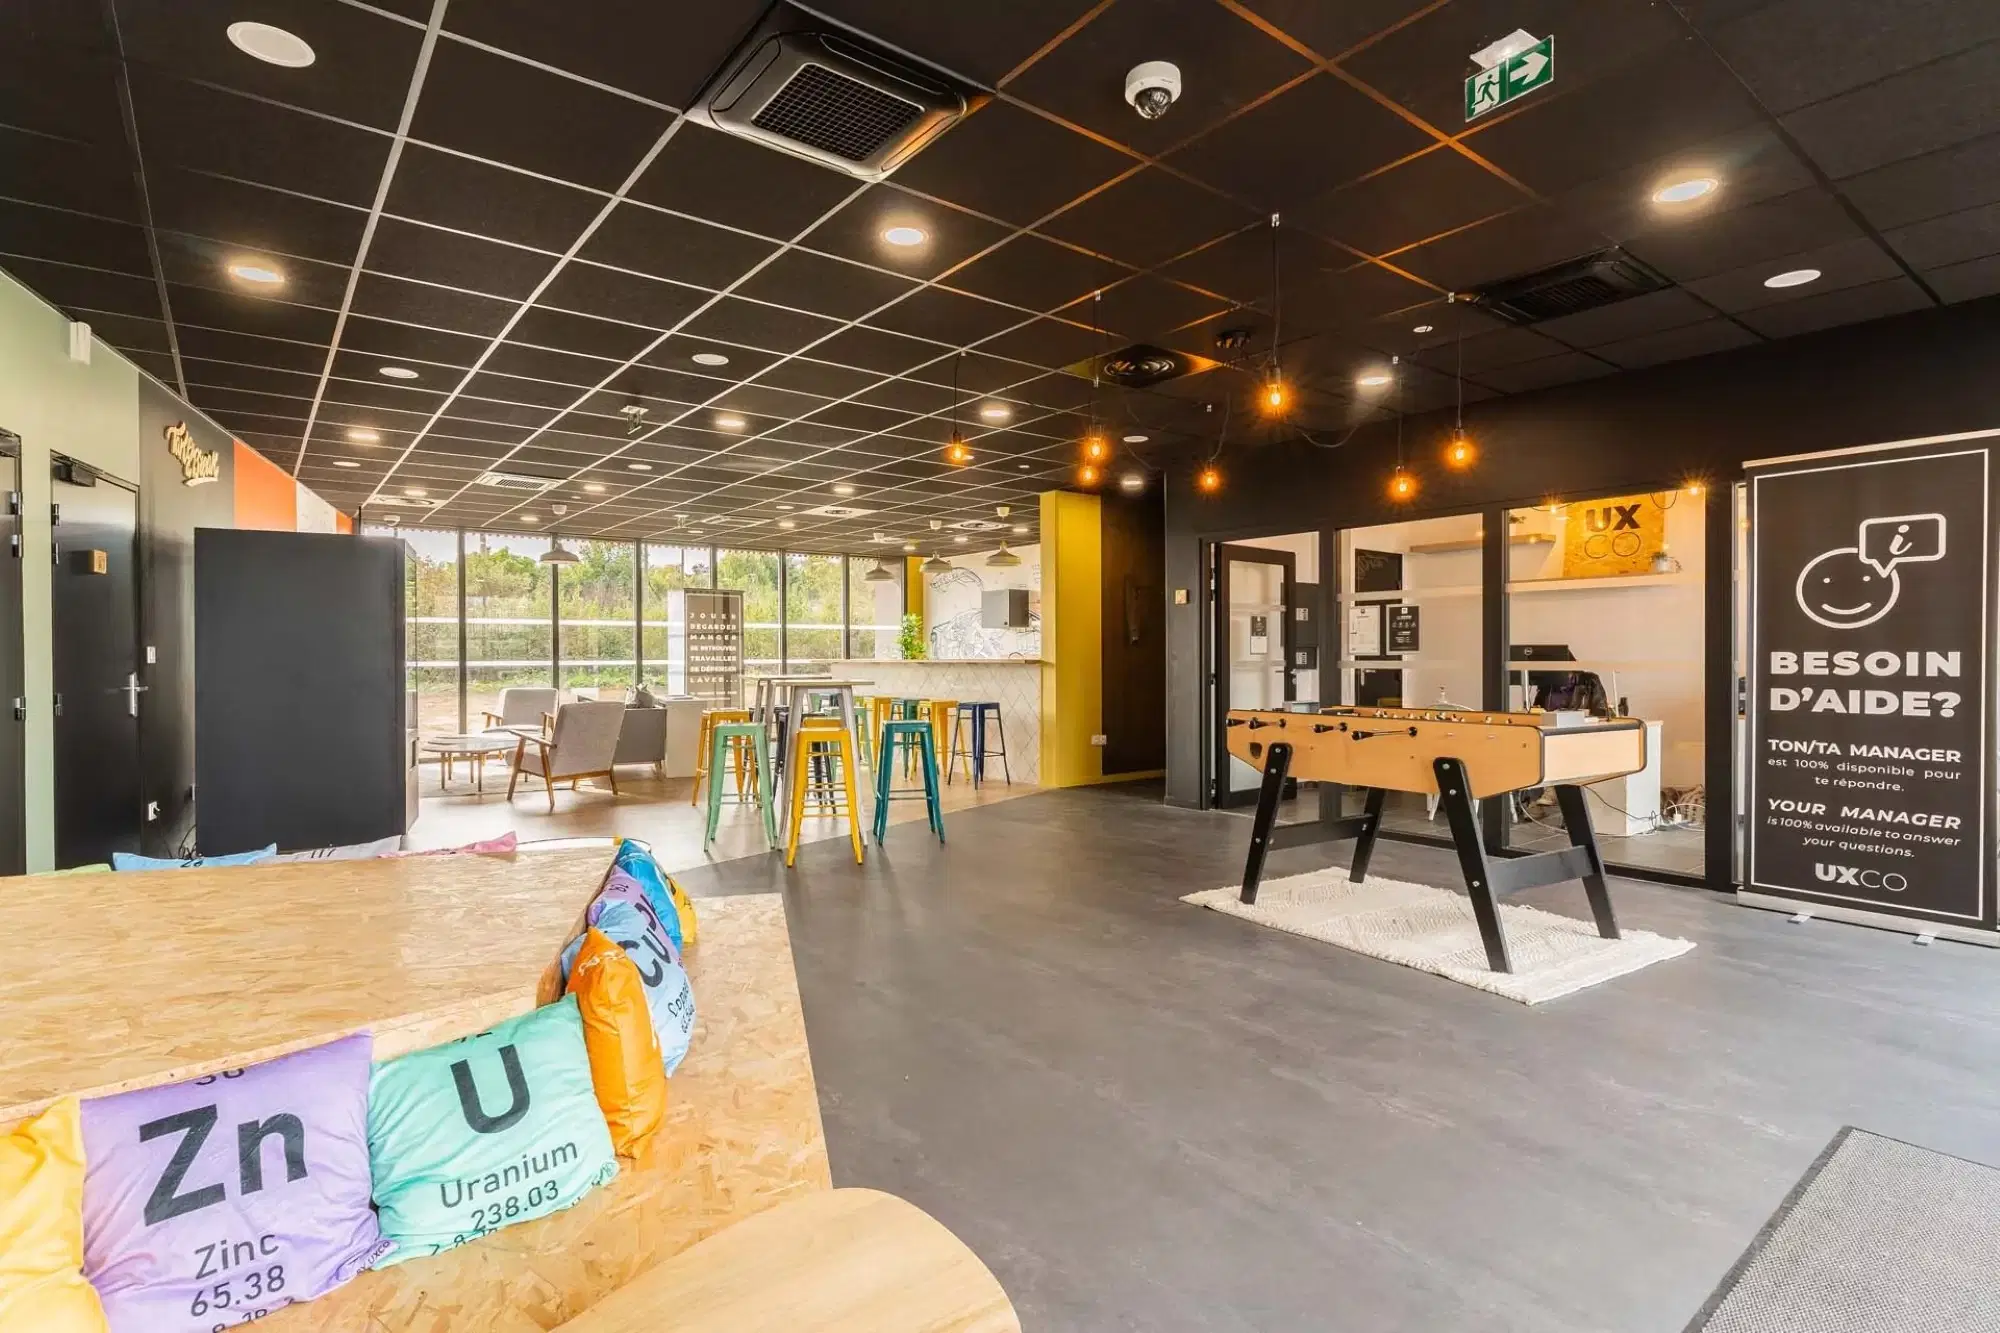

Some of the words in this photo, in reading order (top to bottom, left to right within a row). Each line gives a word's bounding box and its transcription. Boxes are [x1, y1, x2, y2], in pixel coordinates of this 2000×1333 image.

[1586, 504, 1641, 532] UX
[1584, 532, 1641, 559] CO
[1770, 650, 1961, 677] BESOIN
[1767, 738, 1842, 756] TON/TA
[1849, 743, 1962, 763] MANAGER
[1767, 758, 1787, 767] est
[1794, 758, 1829, 770] 100%
[1836, 762, 1915, 777] disponible
[1924, 769, 1962, 782] pour
[1814, 776, 1830, 785] te
[1833, 777, 1905, 792] répondre.
[1768, 798, 1827, 816] YOUR
[1840, 805, 1962, 830] MANAGER
[1767, 815, 1778, 826] is
[1780, 817, 1813, 830] 100%
[1814, 821, 1883, 838] available
[1884, 830, 1901, 840] to
[1902, 833, 1961, 846] answer
[1802, 836, 1836, 848] your
[1838, 841, 1915, 858] questions.
[1815, 862, 1908, 891] UXCO
[449, 1043, 531, 1134] U
[138, 1103, 309, 1227] Zn
[440, 1142, 578, 1208] Uranium
[471, 1179, 559, 1233] 238.03
[194, 1234, 280, 1281] Zinc
[368, 1240, 390, 1264] UXCO
[190, 1264, 285, 1317] 65.38
